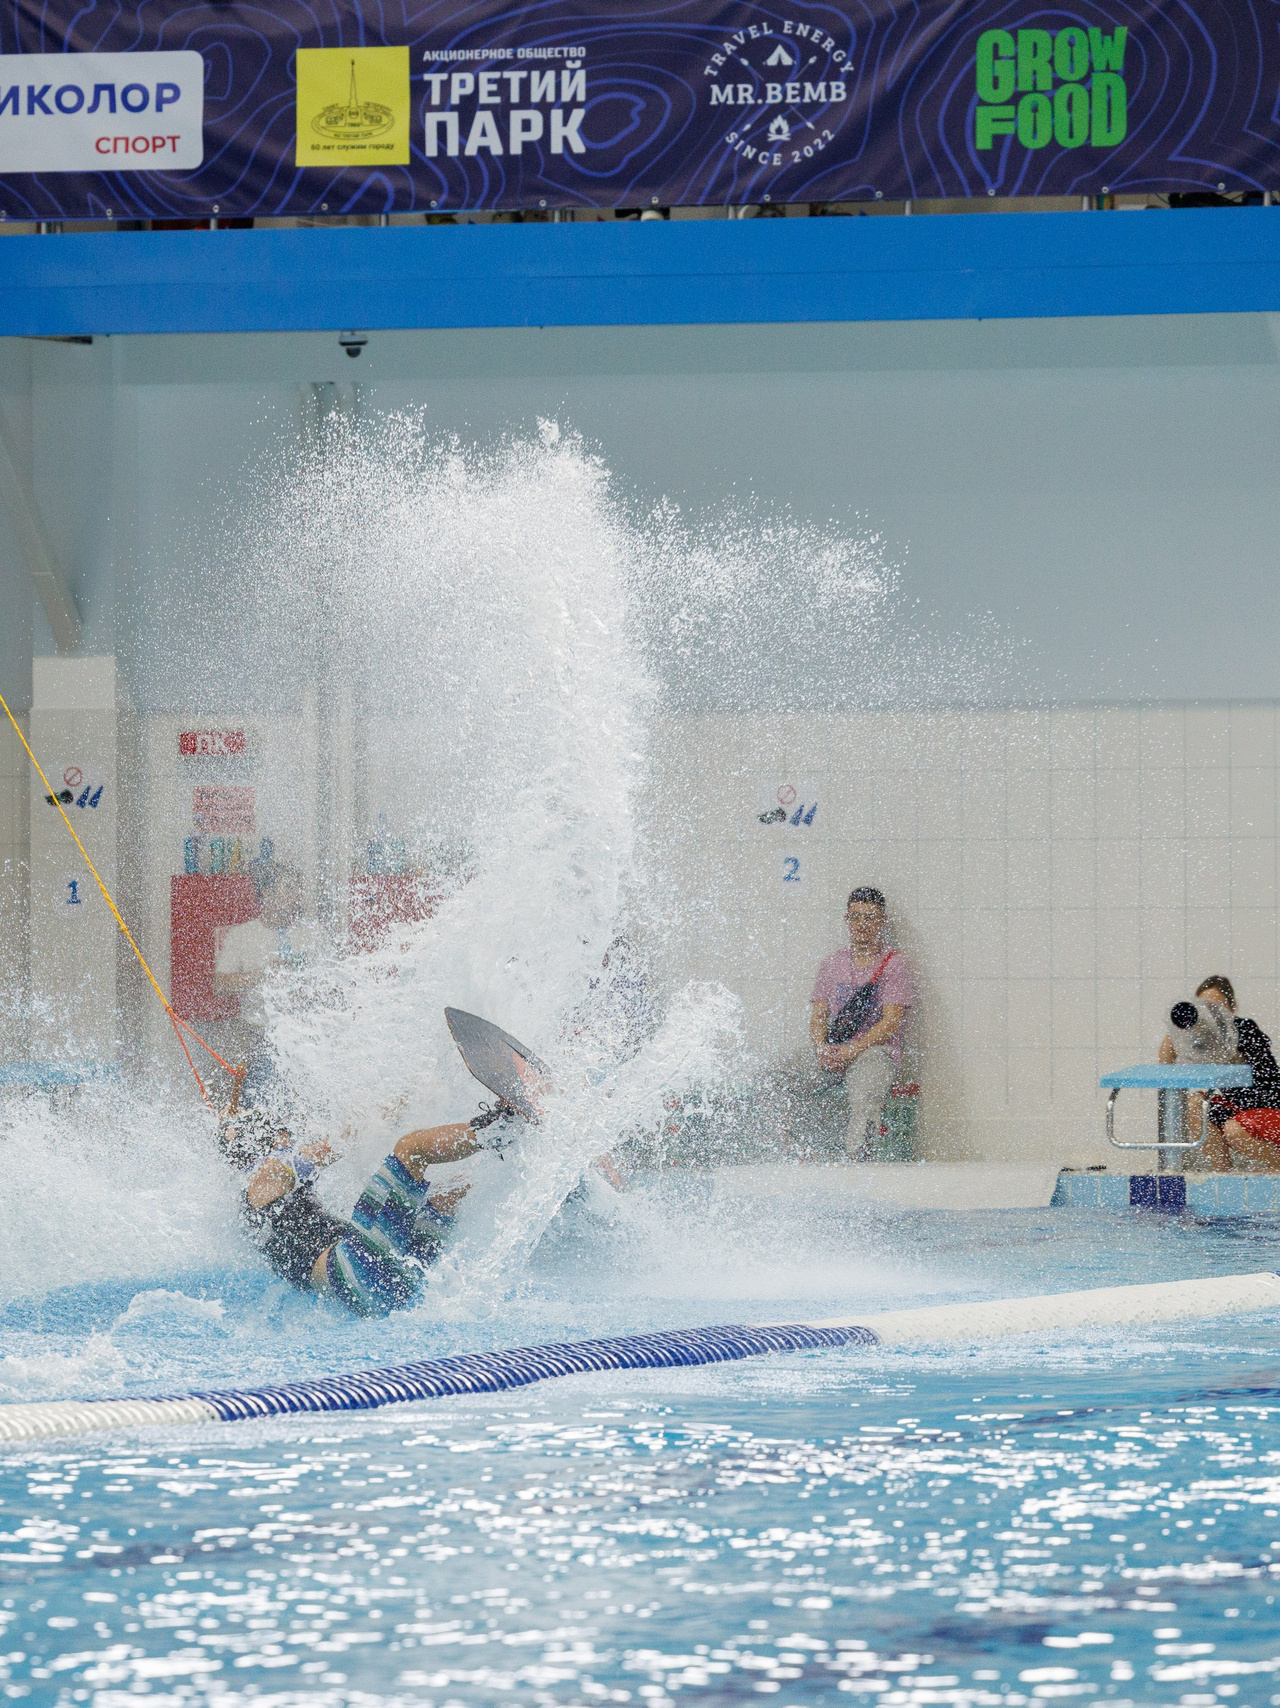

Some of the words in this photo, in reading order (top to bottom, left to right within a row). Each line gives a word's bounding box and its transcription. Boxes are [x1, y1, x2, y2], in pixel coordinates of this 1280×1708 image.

[423, 49, 514, 62] АКЦИОНЕРНОЕ
[517, 46, 586, 59] ОБЩЕСТВО
[703, 22, 773, 77] TRAVEL
[782, 20, 855, 74] ENERGY
[976, 26, 1128, 103] GROW
[423, 60, 586, 105] ТРЕТИЙ
[709, 81, 847, 105] MR.BEMB
[975, 71, 1127, 149] FOOD
[95, 135, 181, 154] СПОРТ
[425, 108, 586, 157] ПАРК
[725, 131, 783, 166] SINCE
[791, 129, 835, 164] 2022
[783, 856, 800, 882] 2
[66, 880, 81, 904] 1
